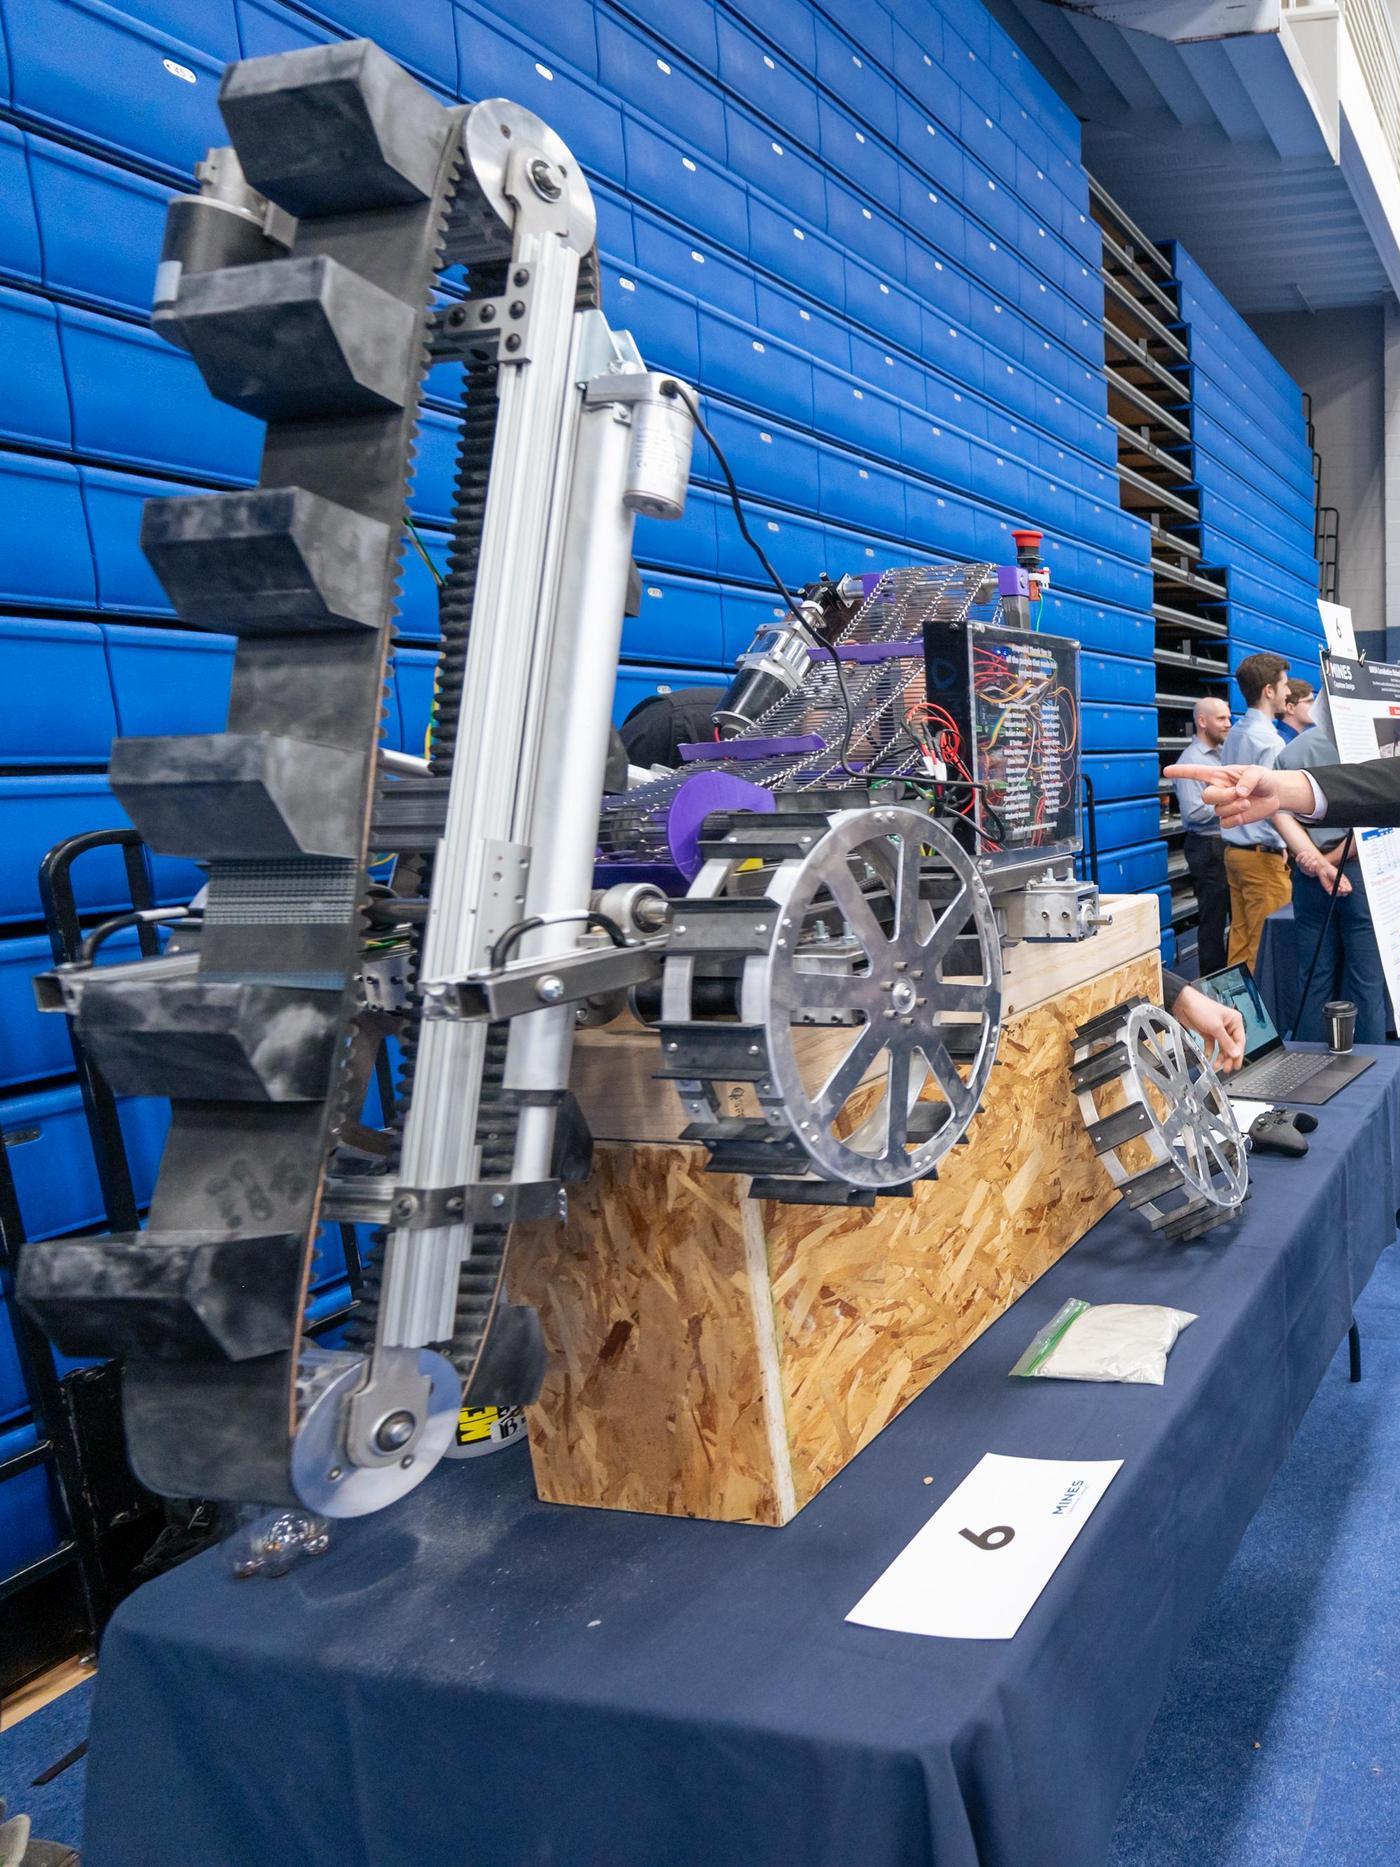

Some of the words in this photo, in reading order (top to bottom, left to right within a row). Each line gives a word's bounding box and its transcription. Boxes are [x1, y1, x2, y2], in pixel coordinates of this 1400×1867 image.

[1335, 617, 1342, 639] 6
[1052, 1480, 1084, 1514] MINES
[958, 1525, 1016, 1551] 6
